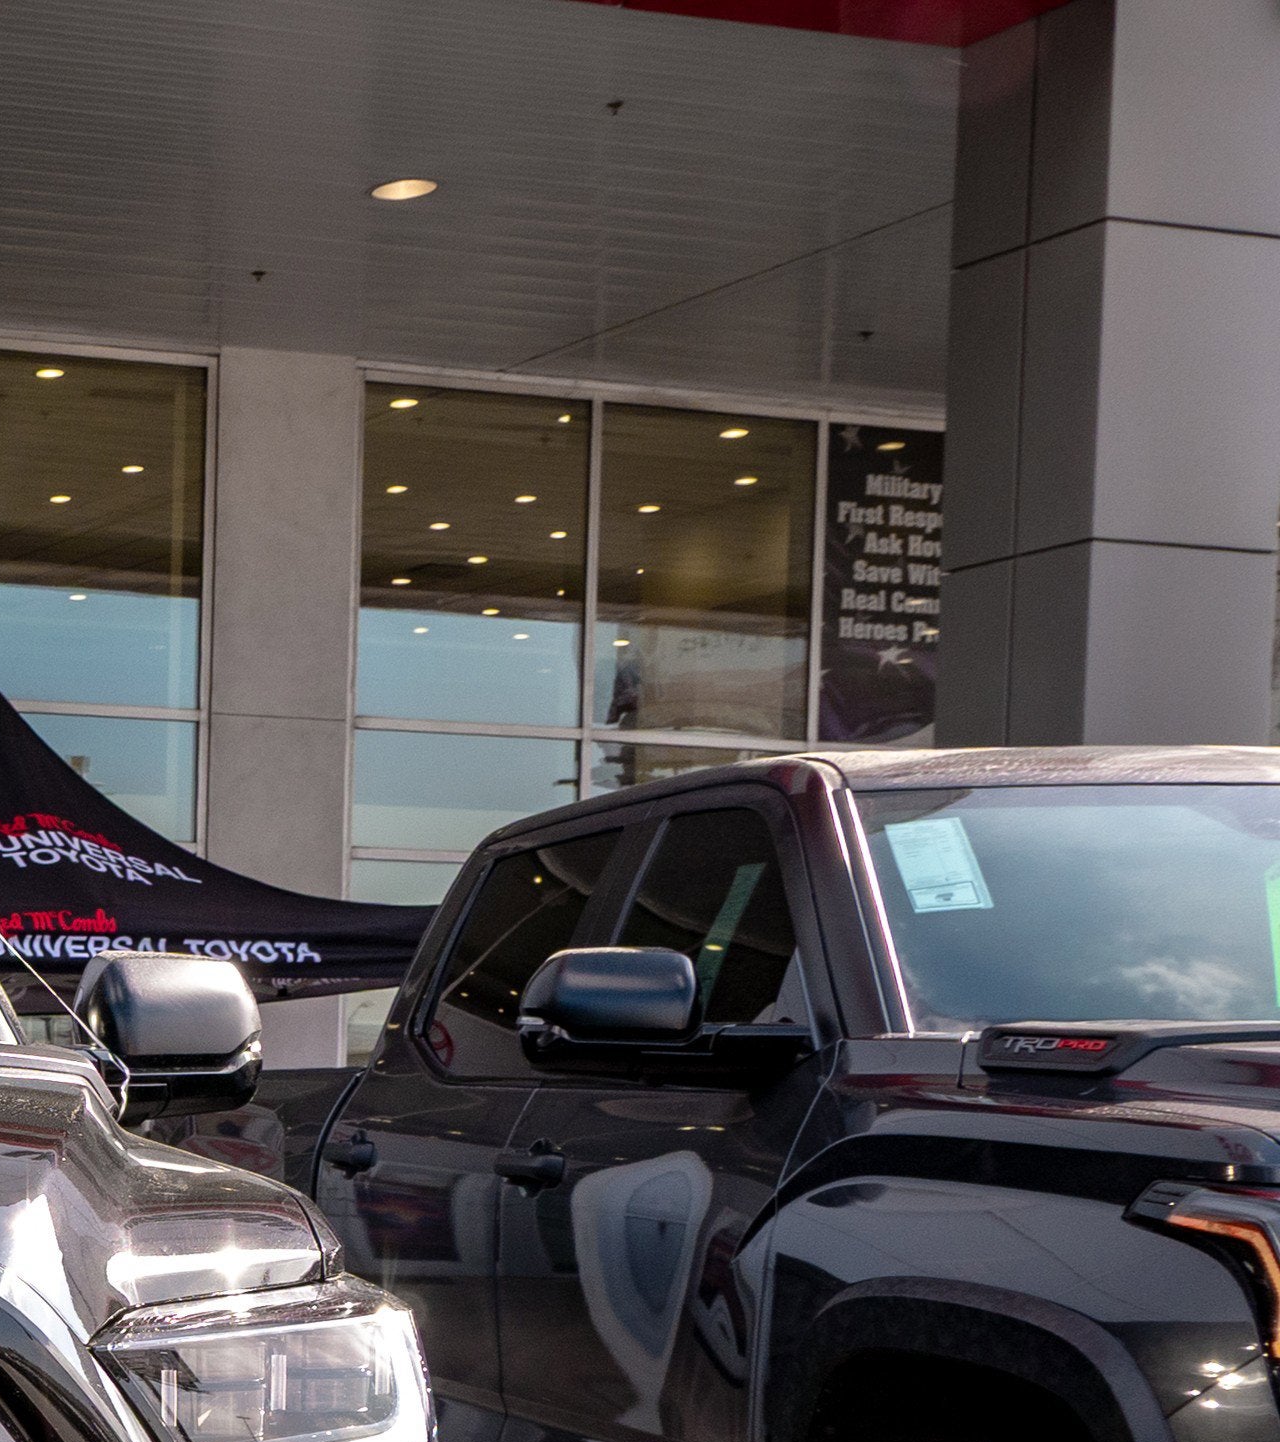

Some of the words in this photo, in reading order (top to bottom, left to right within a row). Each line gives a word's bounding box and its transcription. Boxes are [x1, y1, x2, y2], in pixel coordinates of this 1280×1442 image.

[865, 474, 943, 505] Military
[837, 501, 885, 525] First
[864, 532, 903, 555] Ask
[853, 559, 903, 583] Save
[841, 588, 887, 612] Real
[838, 617, 909, 642] Heroes
[2, 847, 153, 886] TOYOTA
[24, 908, 117, 933] McCombs
[1003, 1036, 1058, 1053] TRD
